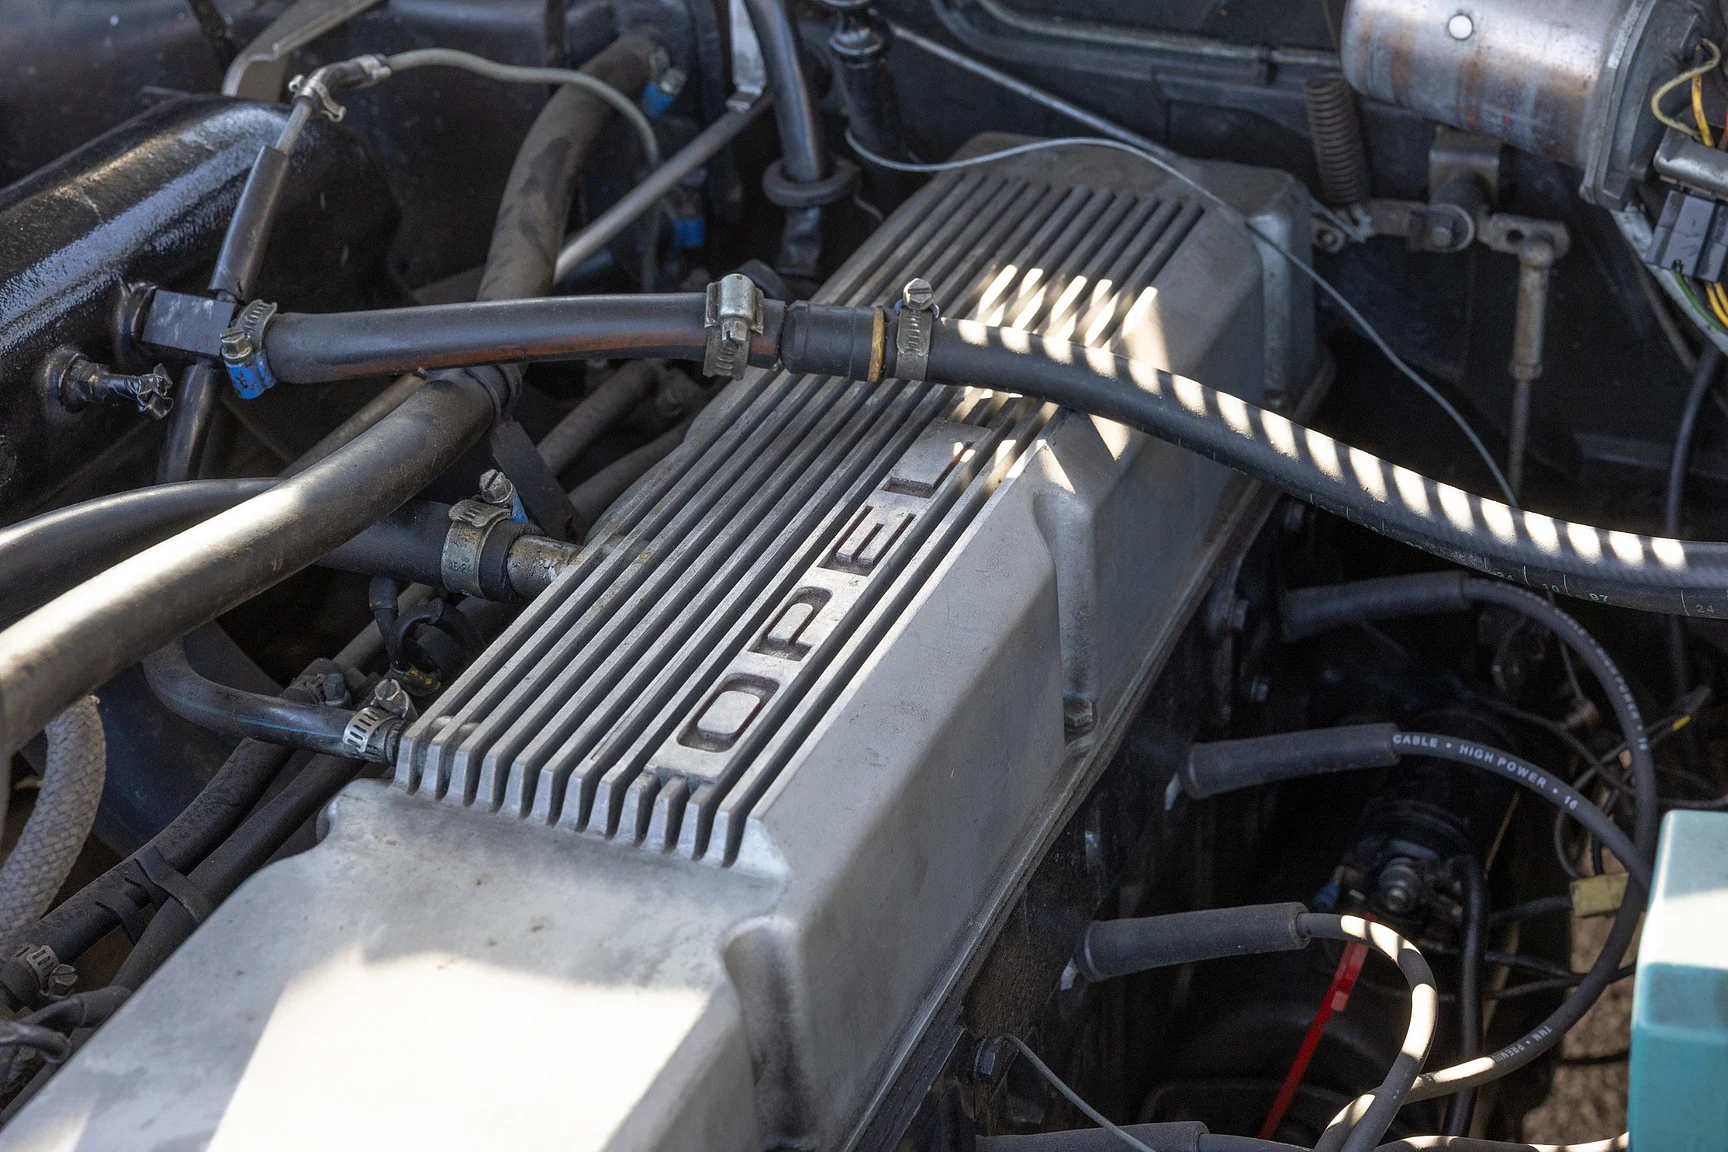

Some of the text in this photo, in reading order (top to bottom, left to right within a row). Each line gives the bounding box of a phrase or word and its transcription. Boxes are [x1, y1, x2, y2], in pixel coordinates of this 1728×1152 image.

[676, 441, 975, 752] OPEL
[1695, 603, 1717, 613] 24
[1392, 733, 1579, 811] CABLE HIGH POWER 16
